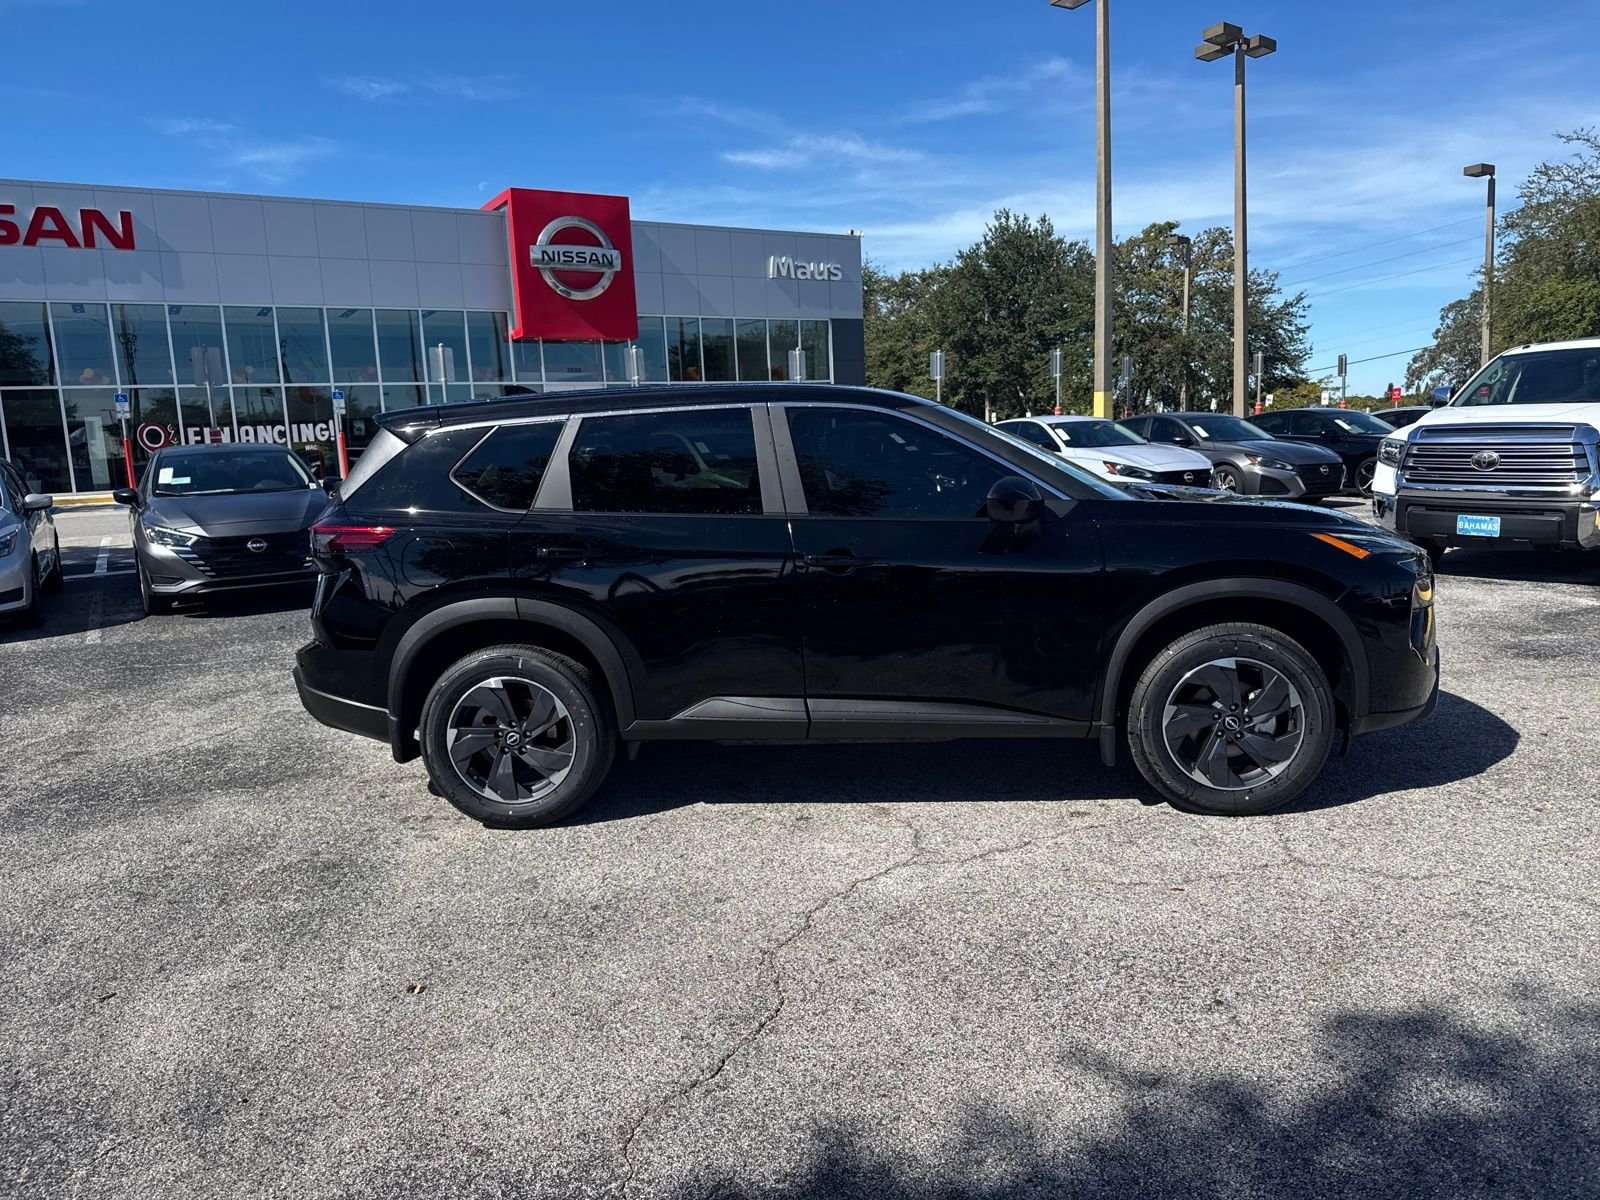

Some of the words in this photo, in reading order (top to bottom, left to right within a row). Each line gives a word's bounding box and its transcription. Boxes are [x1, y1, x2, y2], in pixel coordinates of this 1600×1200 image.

[541, 249, 614, 266] NISSAN
[769, 255, 843, 281] Maus
[187, 419, 336, 446] FINANCING!
[1458, 521, 1498, 532] BAHAMAS
